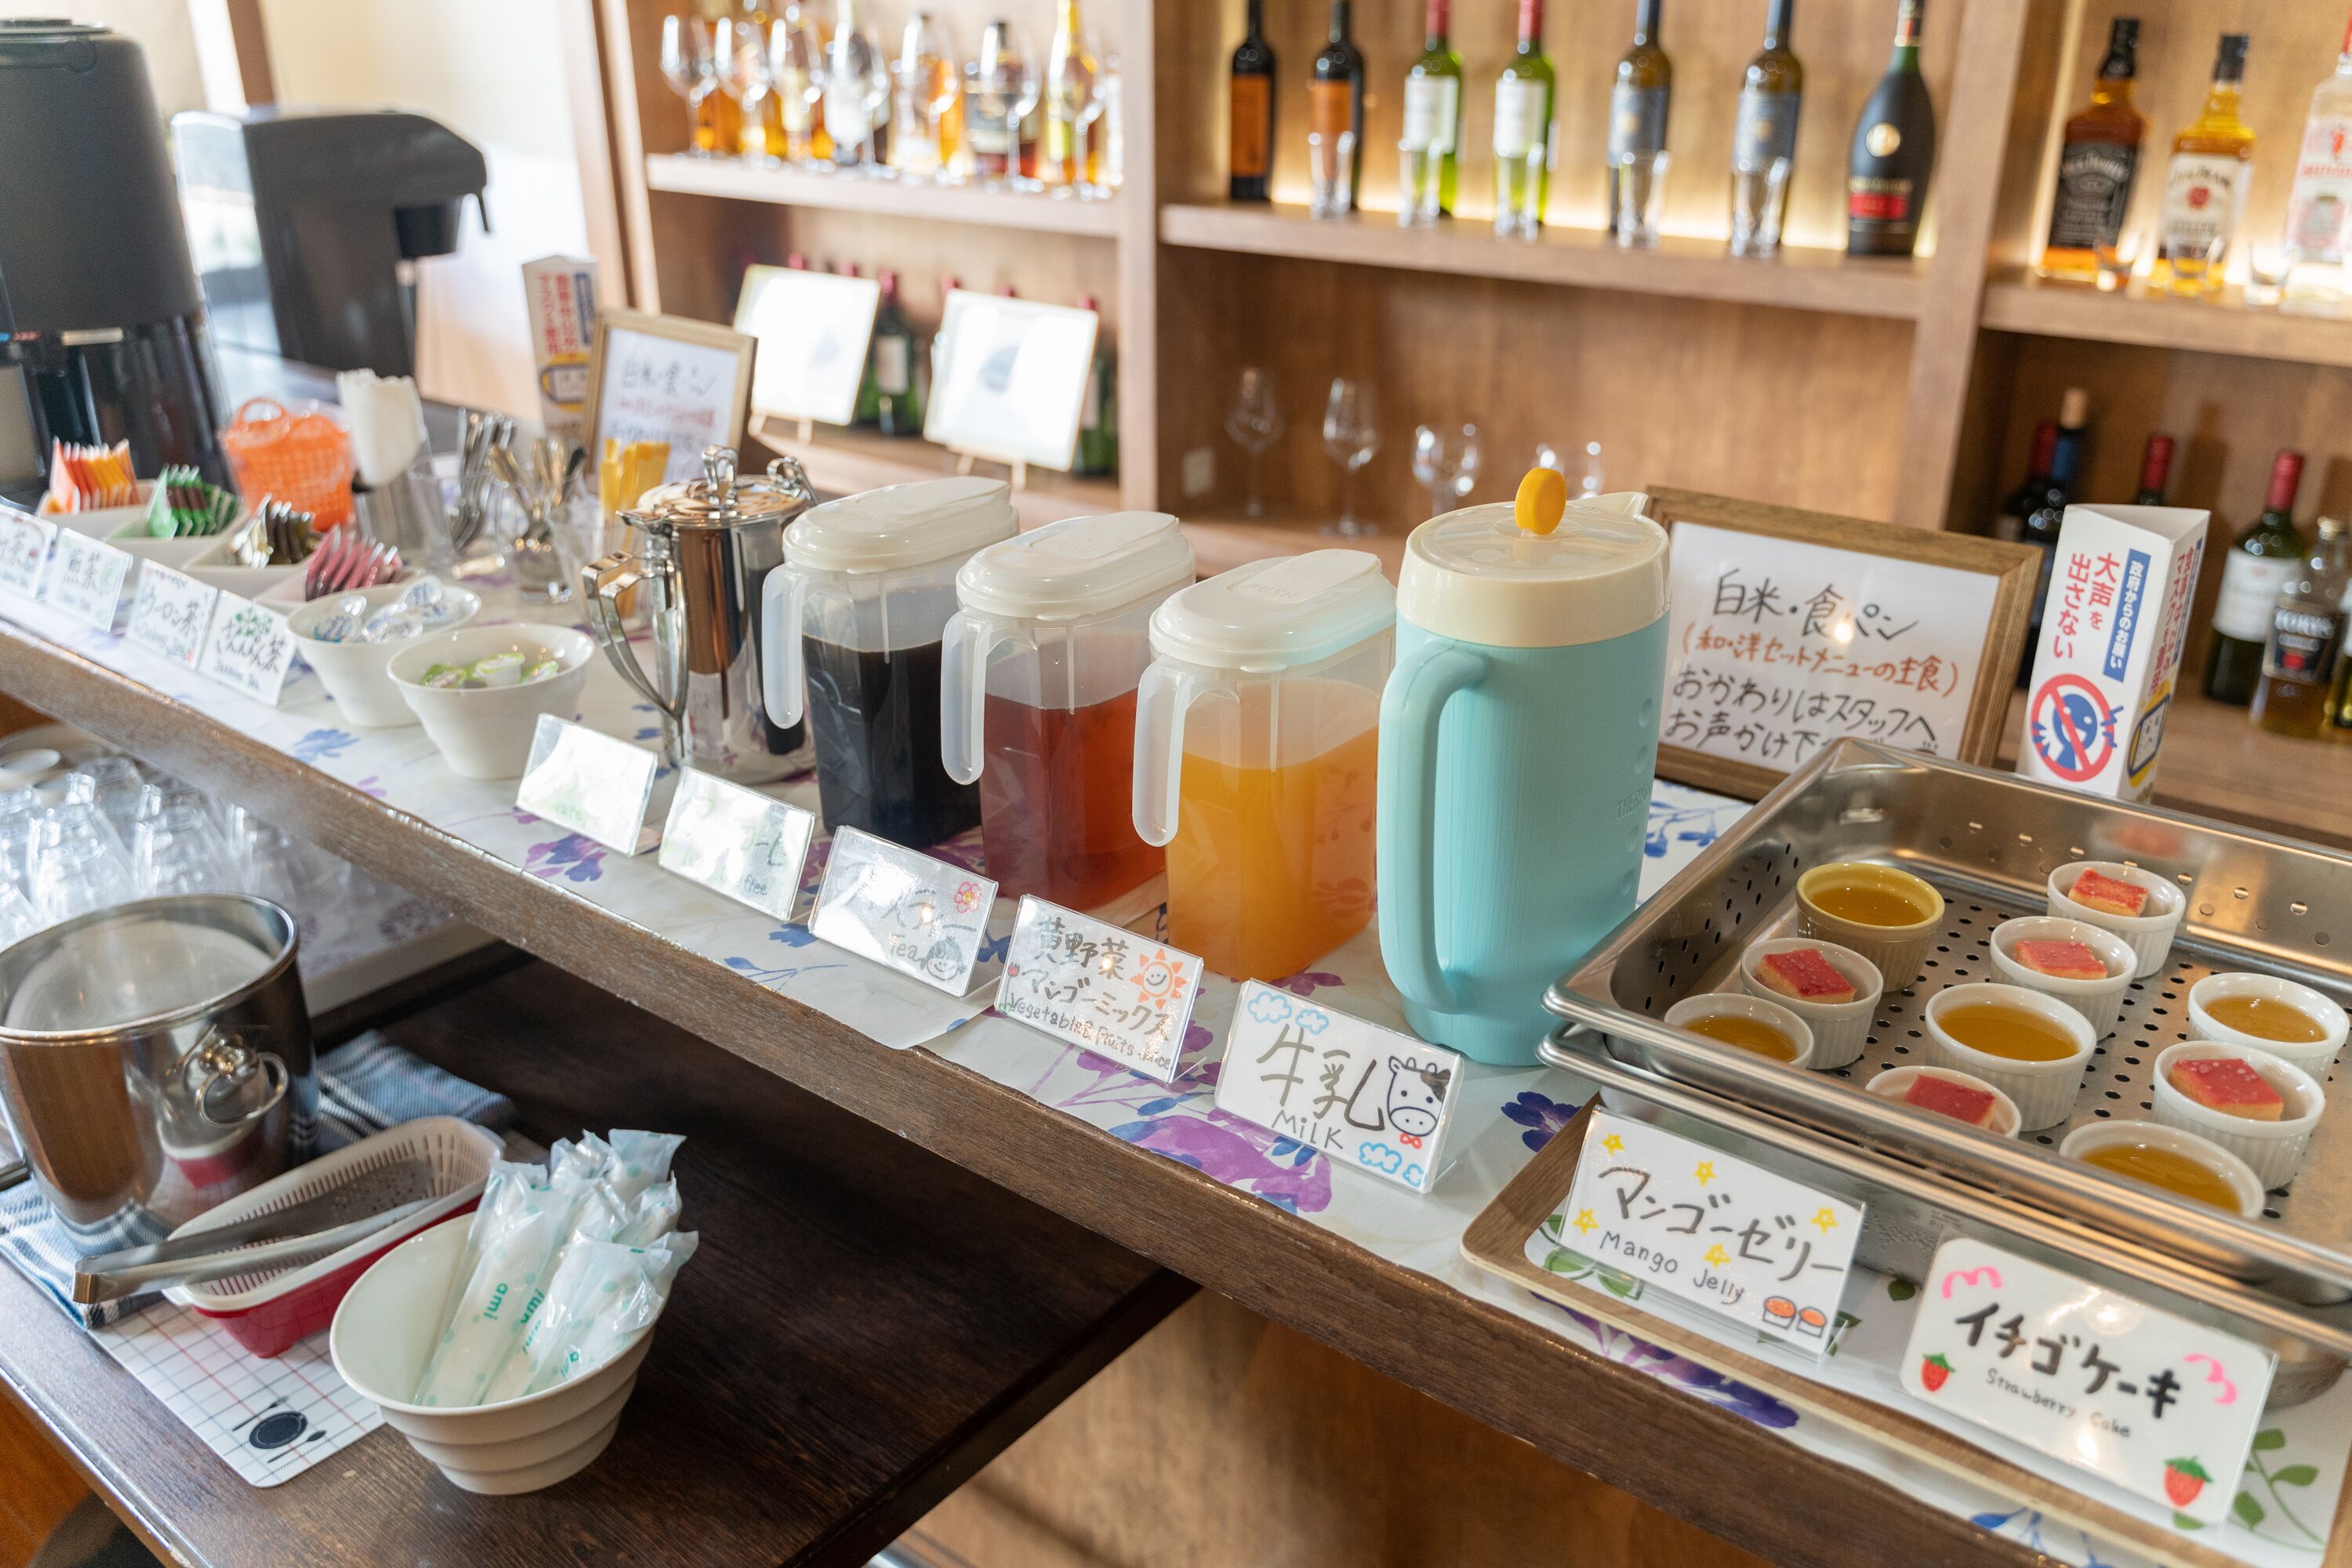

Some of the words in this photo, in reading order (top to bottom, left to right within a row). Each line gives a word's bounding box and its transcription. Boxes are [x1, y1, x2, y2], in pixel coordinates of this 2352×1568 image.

[1713, 568, 1919, 641] 白米・食パン
[2053, 552, 2091, 660] 出さない
[2089, 551, 2120, 630] 大声を
[2111, 560, 2145, 670] 政府からのお願い
[1664, 709, 1833, 763] お声かけ下
[1673, 664, 1937, 742] おかわりはスタッフへ
[1034, 914, 1130, 981] 黄野菜
[1094, 1025, 1135, 1057] Fruits
[1256, 1022, 1386, 1131] 牛乳
[1597, 1165, 1846, 1282] マンゴーゼリー
[483, 1282, 509, 1321] ami
[1599, 1229, 1679, 1274] Mango
[1692, 1268, 1745, 1305] Jelly
[1954, 1301, 2182, 1420] イチゴケーキ
[1985, 1367, 2077, 1419] Strawberry
[2089, 1411, 2132, 1439] Cake
